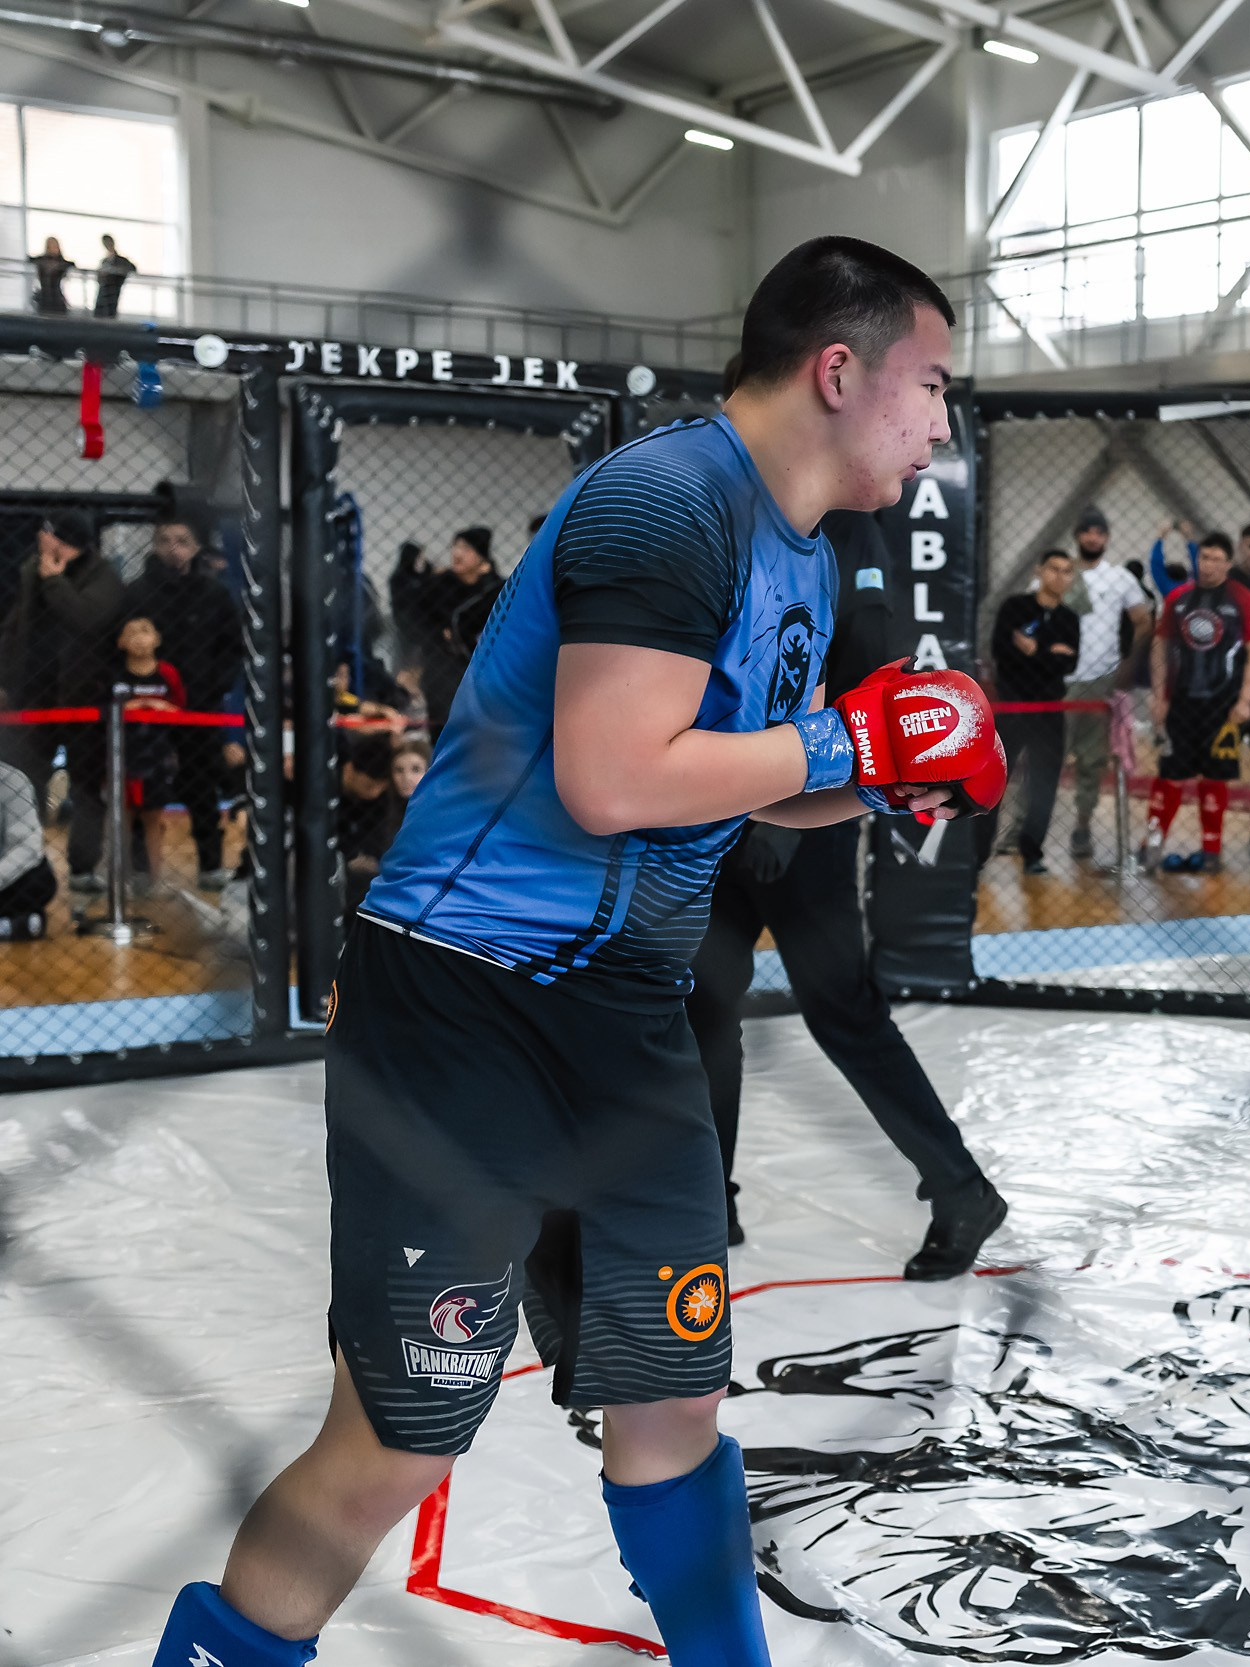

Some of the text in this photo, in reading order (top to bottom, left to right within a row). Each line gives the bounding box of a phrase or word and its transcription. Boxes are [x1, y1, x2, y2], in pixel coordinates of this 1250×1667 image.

[284, 340, 579, 389] JEKPE JEK
[899, 706, 952, 727] GREEN
[902, 717, 947, 738] HILL
[855, 727, 877, 776] IMMAF
[408, 1345, 496, 1378] PANKRATION
